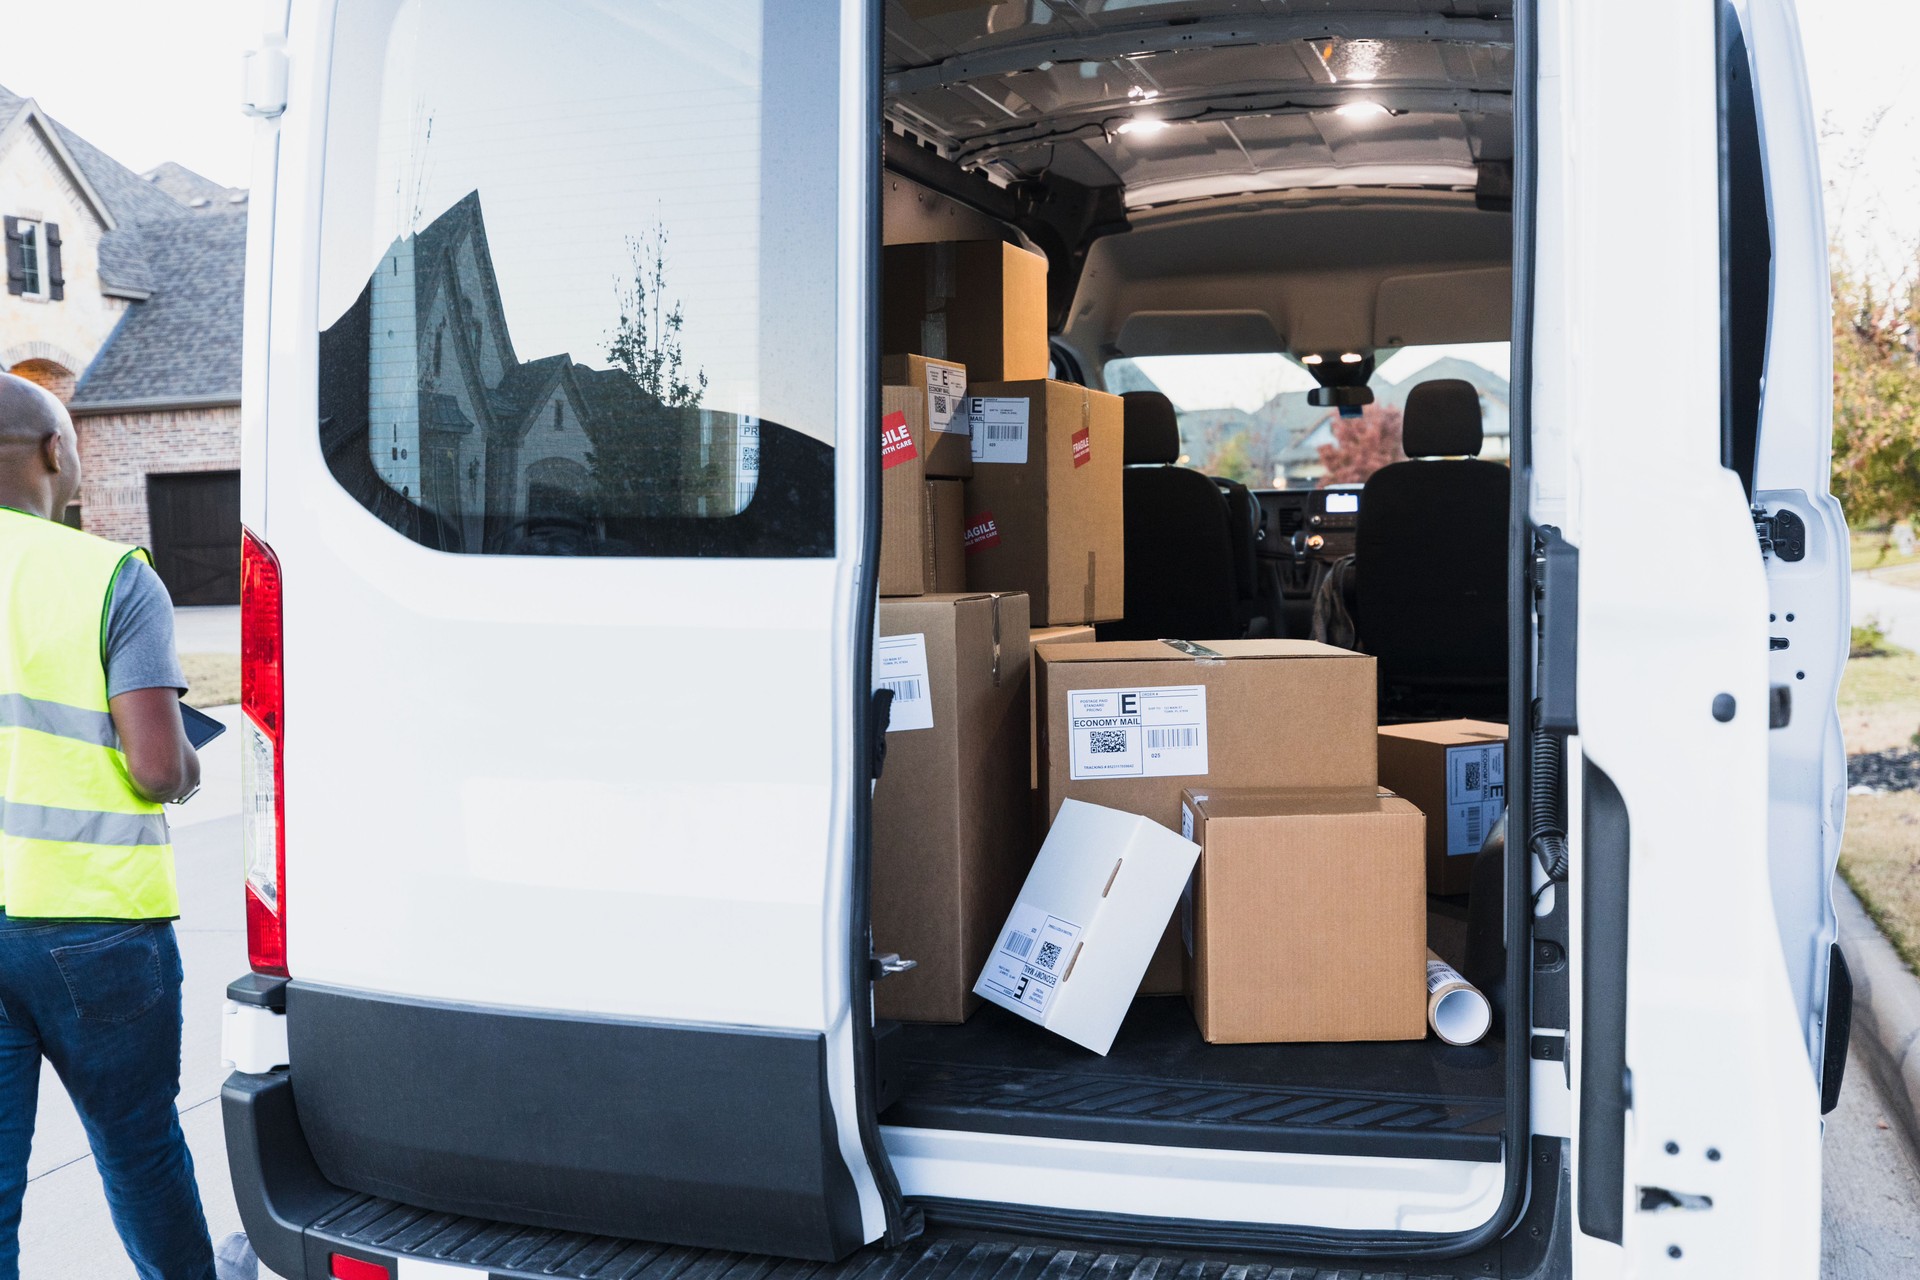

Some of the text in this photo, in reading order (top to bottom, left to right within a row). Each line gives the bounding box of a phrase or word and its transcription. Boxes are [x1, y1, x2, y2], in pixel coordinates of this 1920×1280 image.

[943, 370, 948, 385] E
[972, 399, 982, 413] E
[896, 439, 912, 450] CARE
[1072, 437, 1089, 454] FRAGILE
[986, 530, 997, 538] CARE
[1122, 694, 1137, 714] E
[1074, 719, 1118, 728] ECONOMY
[1490, 786, 1504, 798] E
[1025, 964, 1034, 975] MAIL
[1034, 970, 1057, 986] ECONOMY
[1014, 976, 1028, 1000] E
